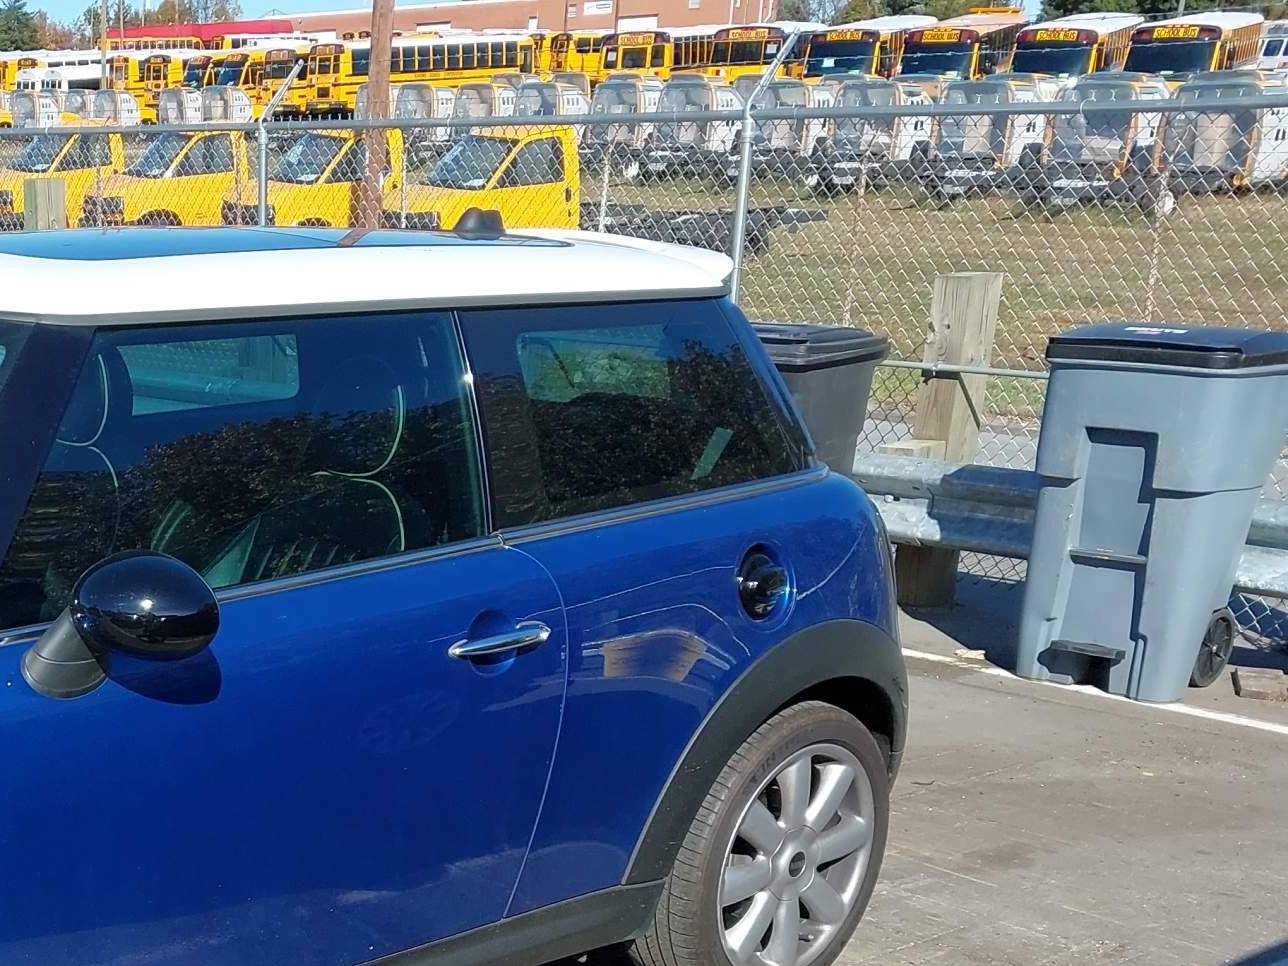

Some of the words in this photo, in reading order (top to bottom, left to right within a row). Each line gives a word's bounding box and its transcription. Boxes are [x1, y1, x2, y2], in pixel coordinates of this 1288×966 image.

[829, 31, 848, 40] SCHOOL
[849, 31, 861, 40] BUS
[922, 32, 946, 40] SCHOOL
[947, 32, 959, 40] BUS
[1039, 31, 1062, 40] SCHOOL
[1063, 31, 1076, 40] BUS
[1155, 28, 1180, 37] SCHOOL
[1183, 27, 1197, 36] BUS
